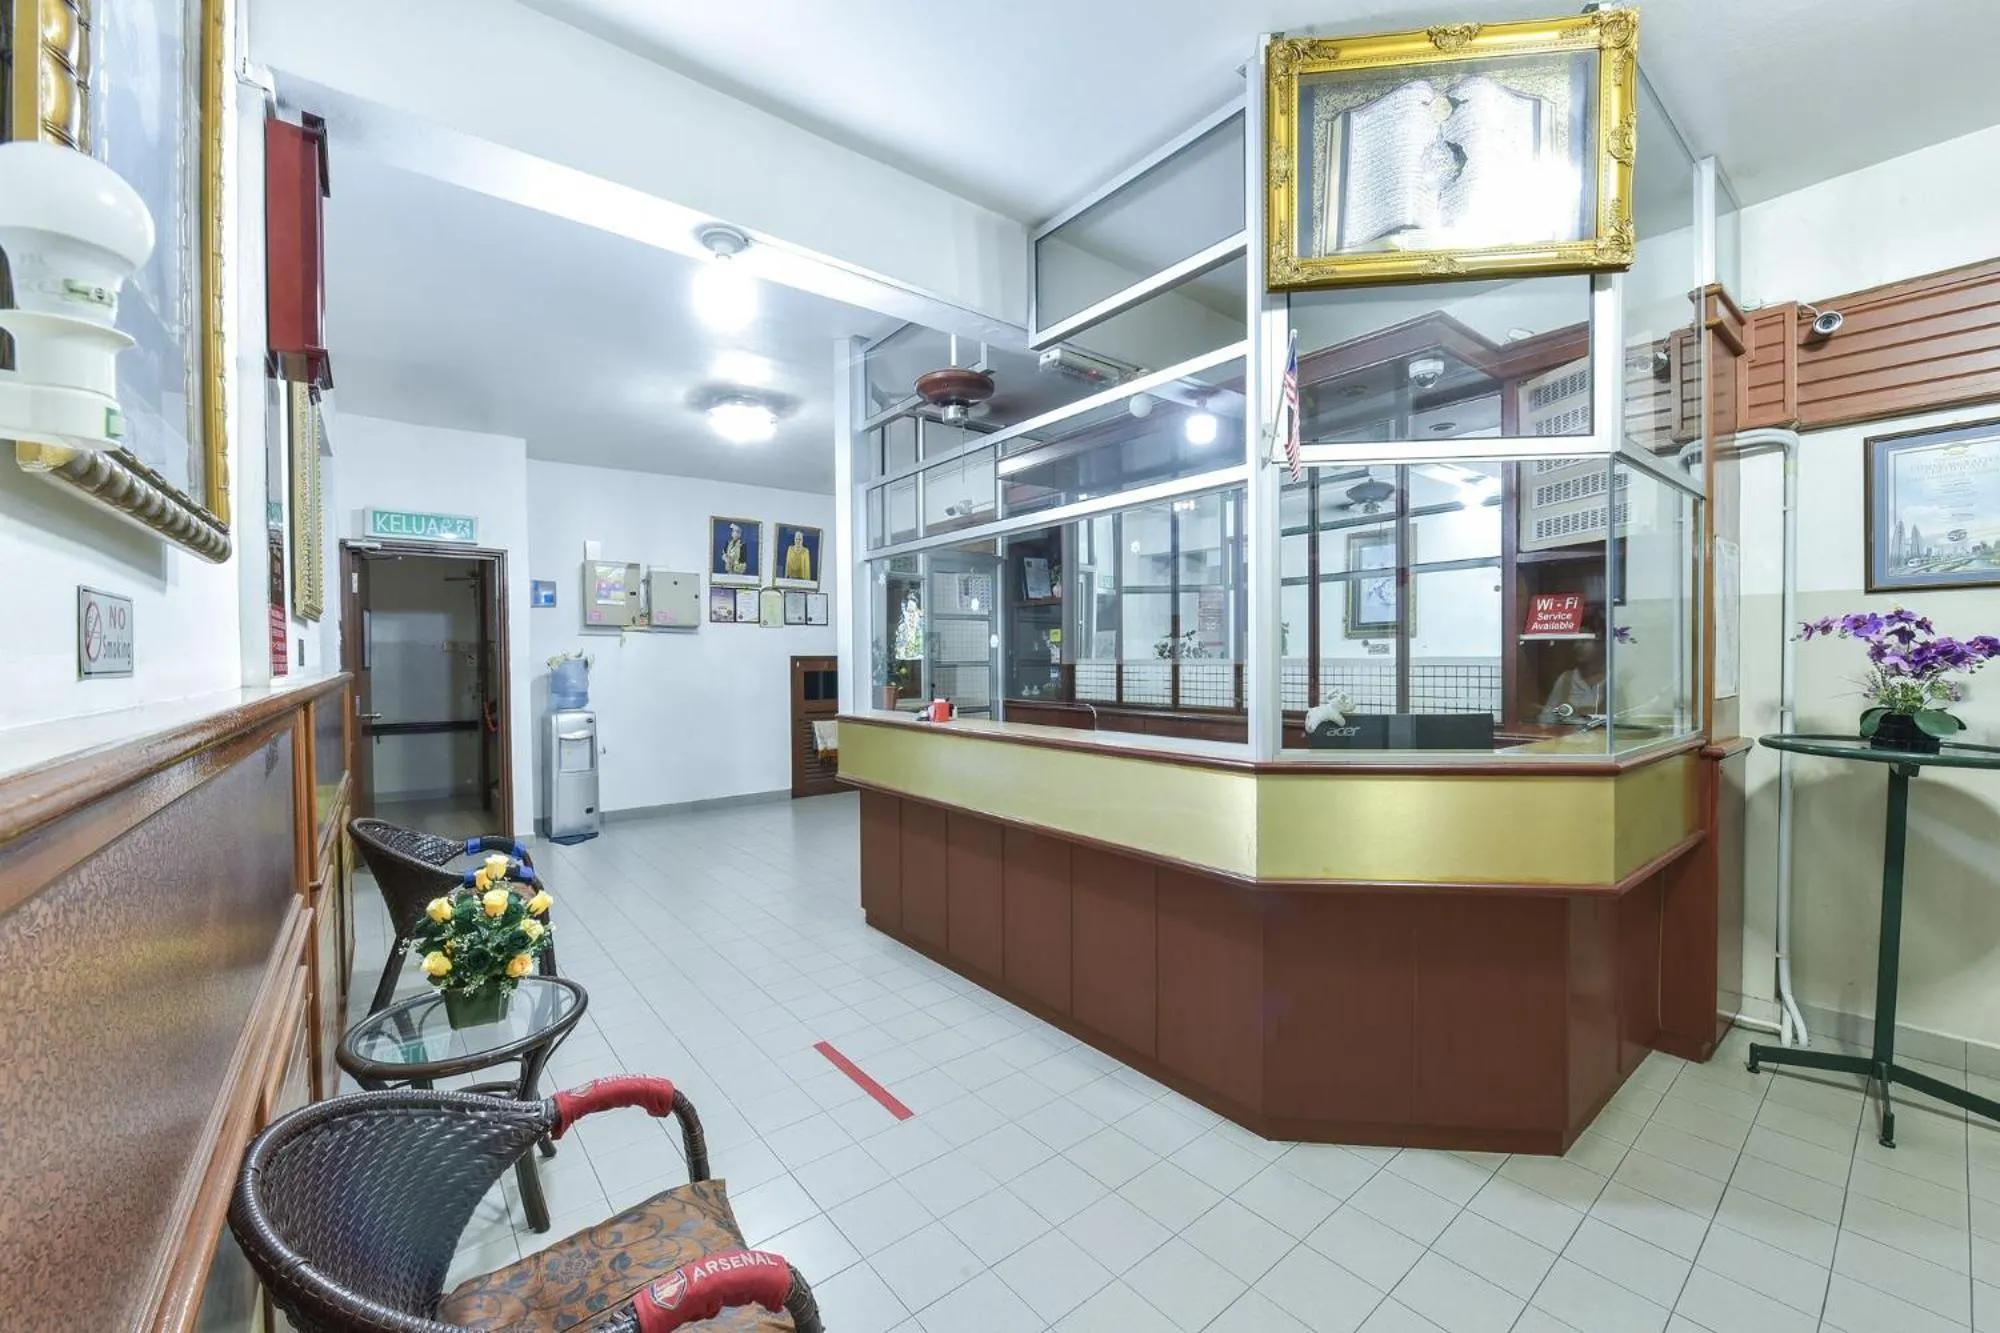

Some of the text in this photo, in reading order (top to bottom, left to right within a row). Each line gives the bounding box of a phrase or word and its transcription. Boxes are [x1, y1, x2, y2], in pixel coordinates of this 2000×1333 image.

[375, 512, 454, 537] KELUAR
[1536, 597, 1554, 611] Wi
[1565, 596, 1579, 610] Fi
[109, 605, 126, 630] NO
[1531, 621, 1575, 631] Available
[1536, 612, 1573, 621] Service
[103, 633, 131, 665] Smoking
[1326, 726, 1361, 737] acer
[693, 1252, 777, 1282] ARSENAL
